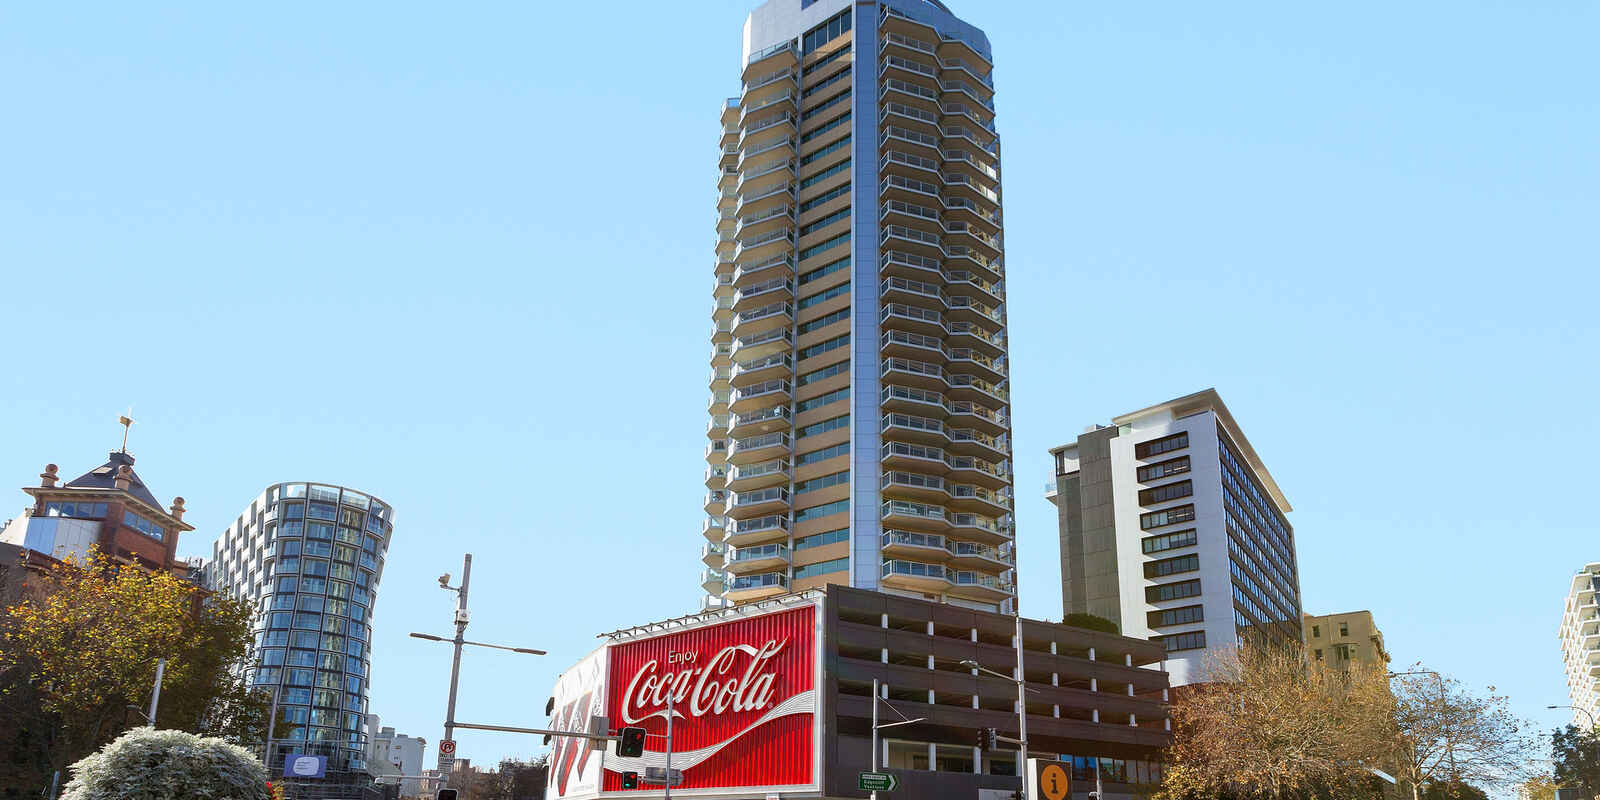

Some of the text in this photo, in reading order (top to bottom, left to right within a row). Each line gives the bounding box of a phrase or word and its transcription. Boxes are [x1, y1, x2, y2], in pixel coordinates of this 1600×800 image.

[668, 650, 699, 664] Enjoy
[621, 635, 789, 724] Coca-Cola
[1050, 772, 1059, 794] i
